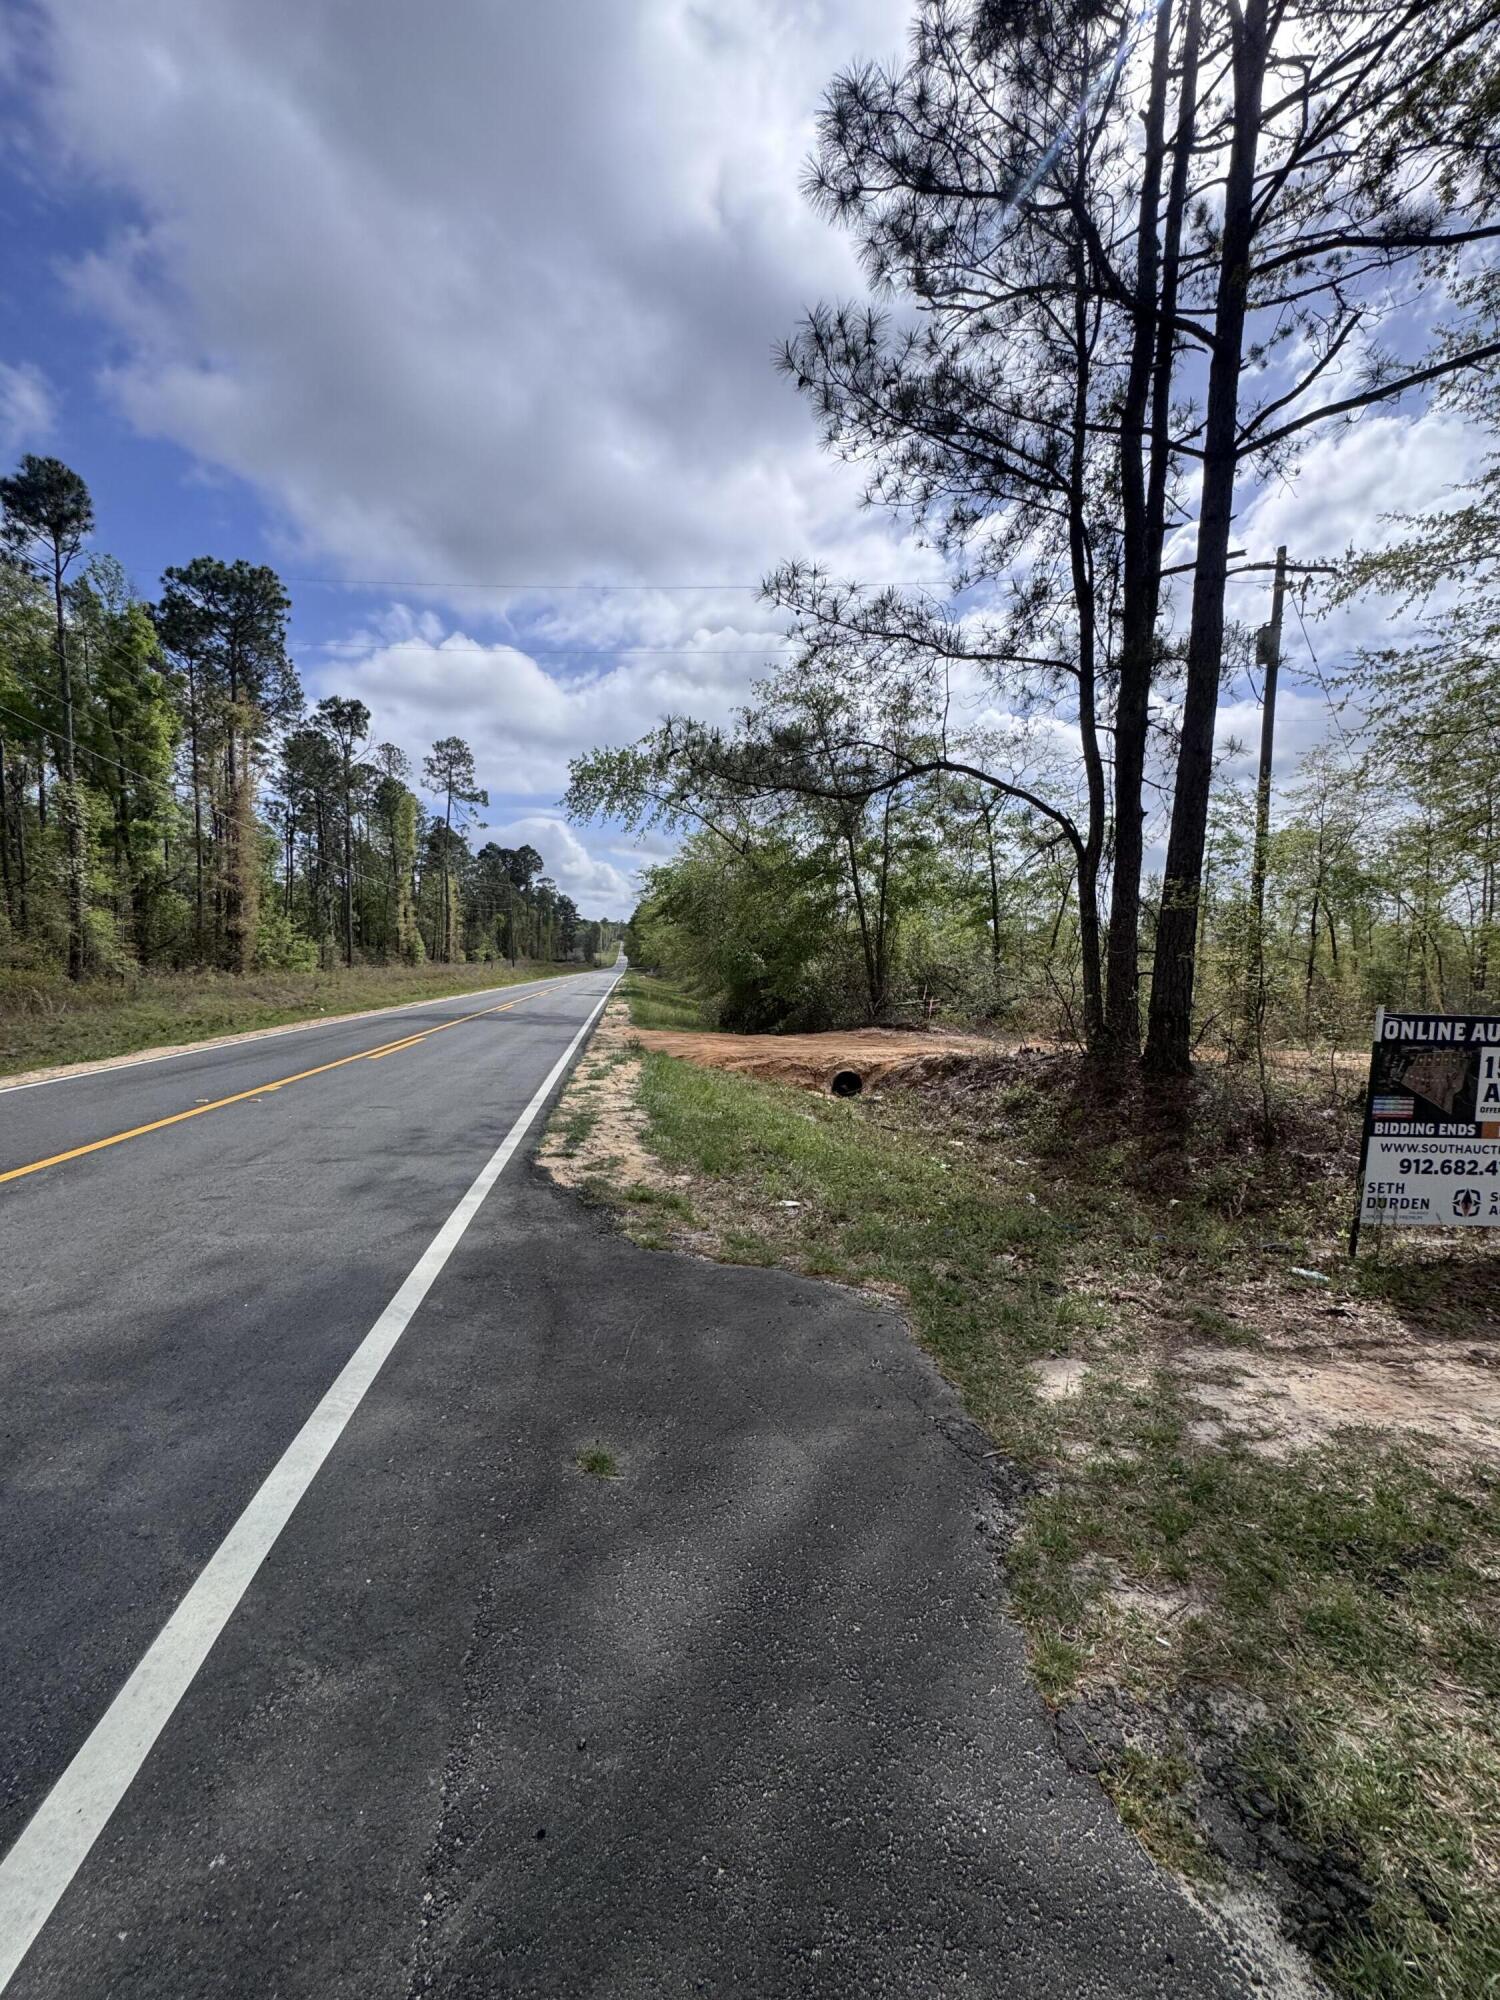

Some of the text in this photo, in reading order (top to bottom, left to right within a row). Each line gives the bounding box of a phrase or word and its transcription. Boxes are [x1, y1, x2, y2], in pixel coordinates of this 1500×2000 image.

[1384, 1021, 1466, 1041] ONLINE
[1374, 1122, 1477, 1136] BIDDING ENDS
[1399, 1158, 1500, 1176] 912.682.4
[1367, 1182, 1405, 1195] SETH
[1366, 1197, 1430, 1210] DURDEN
